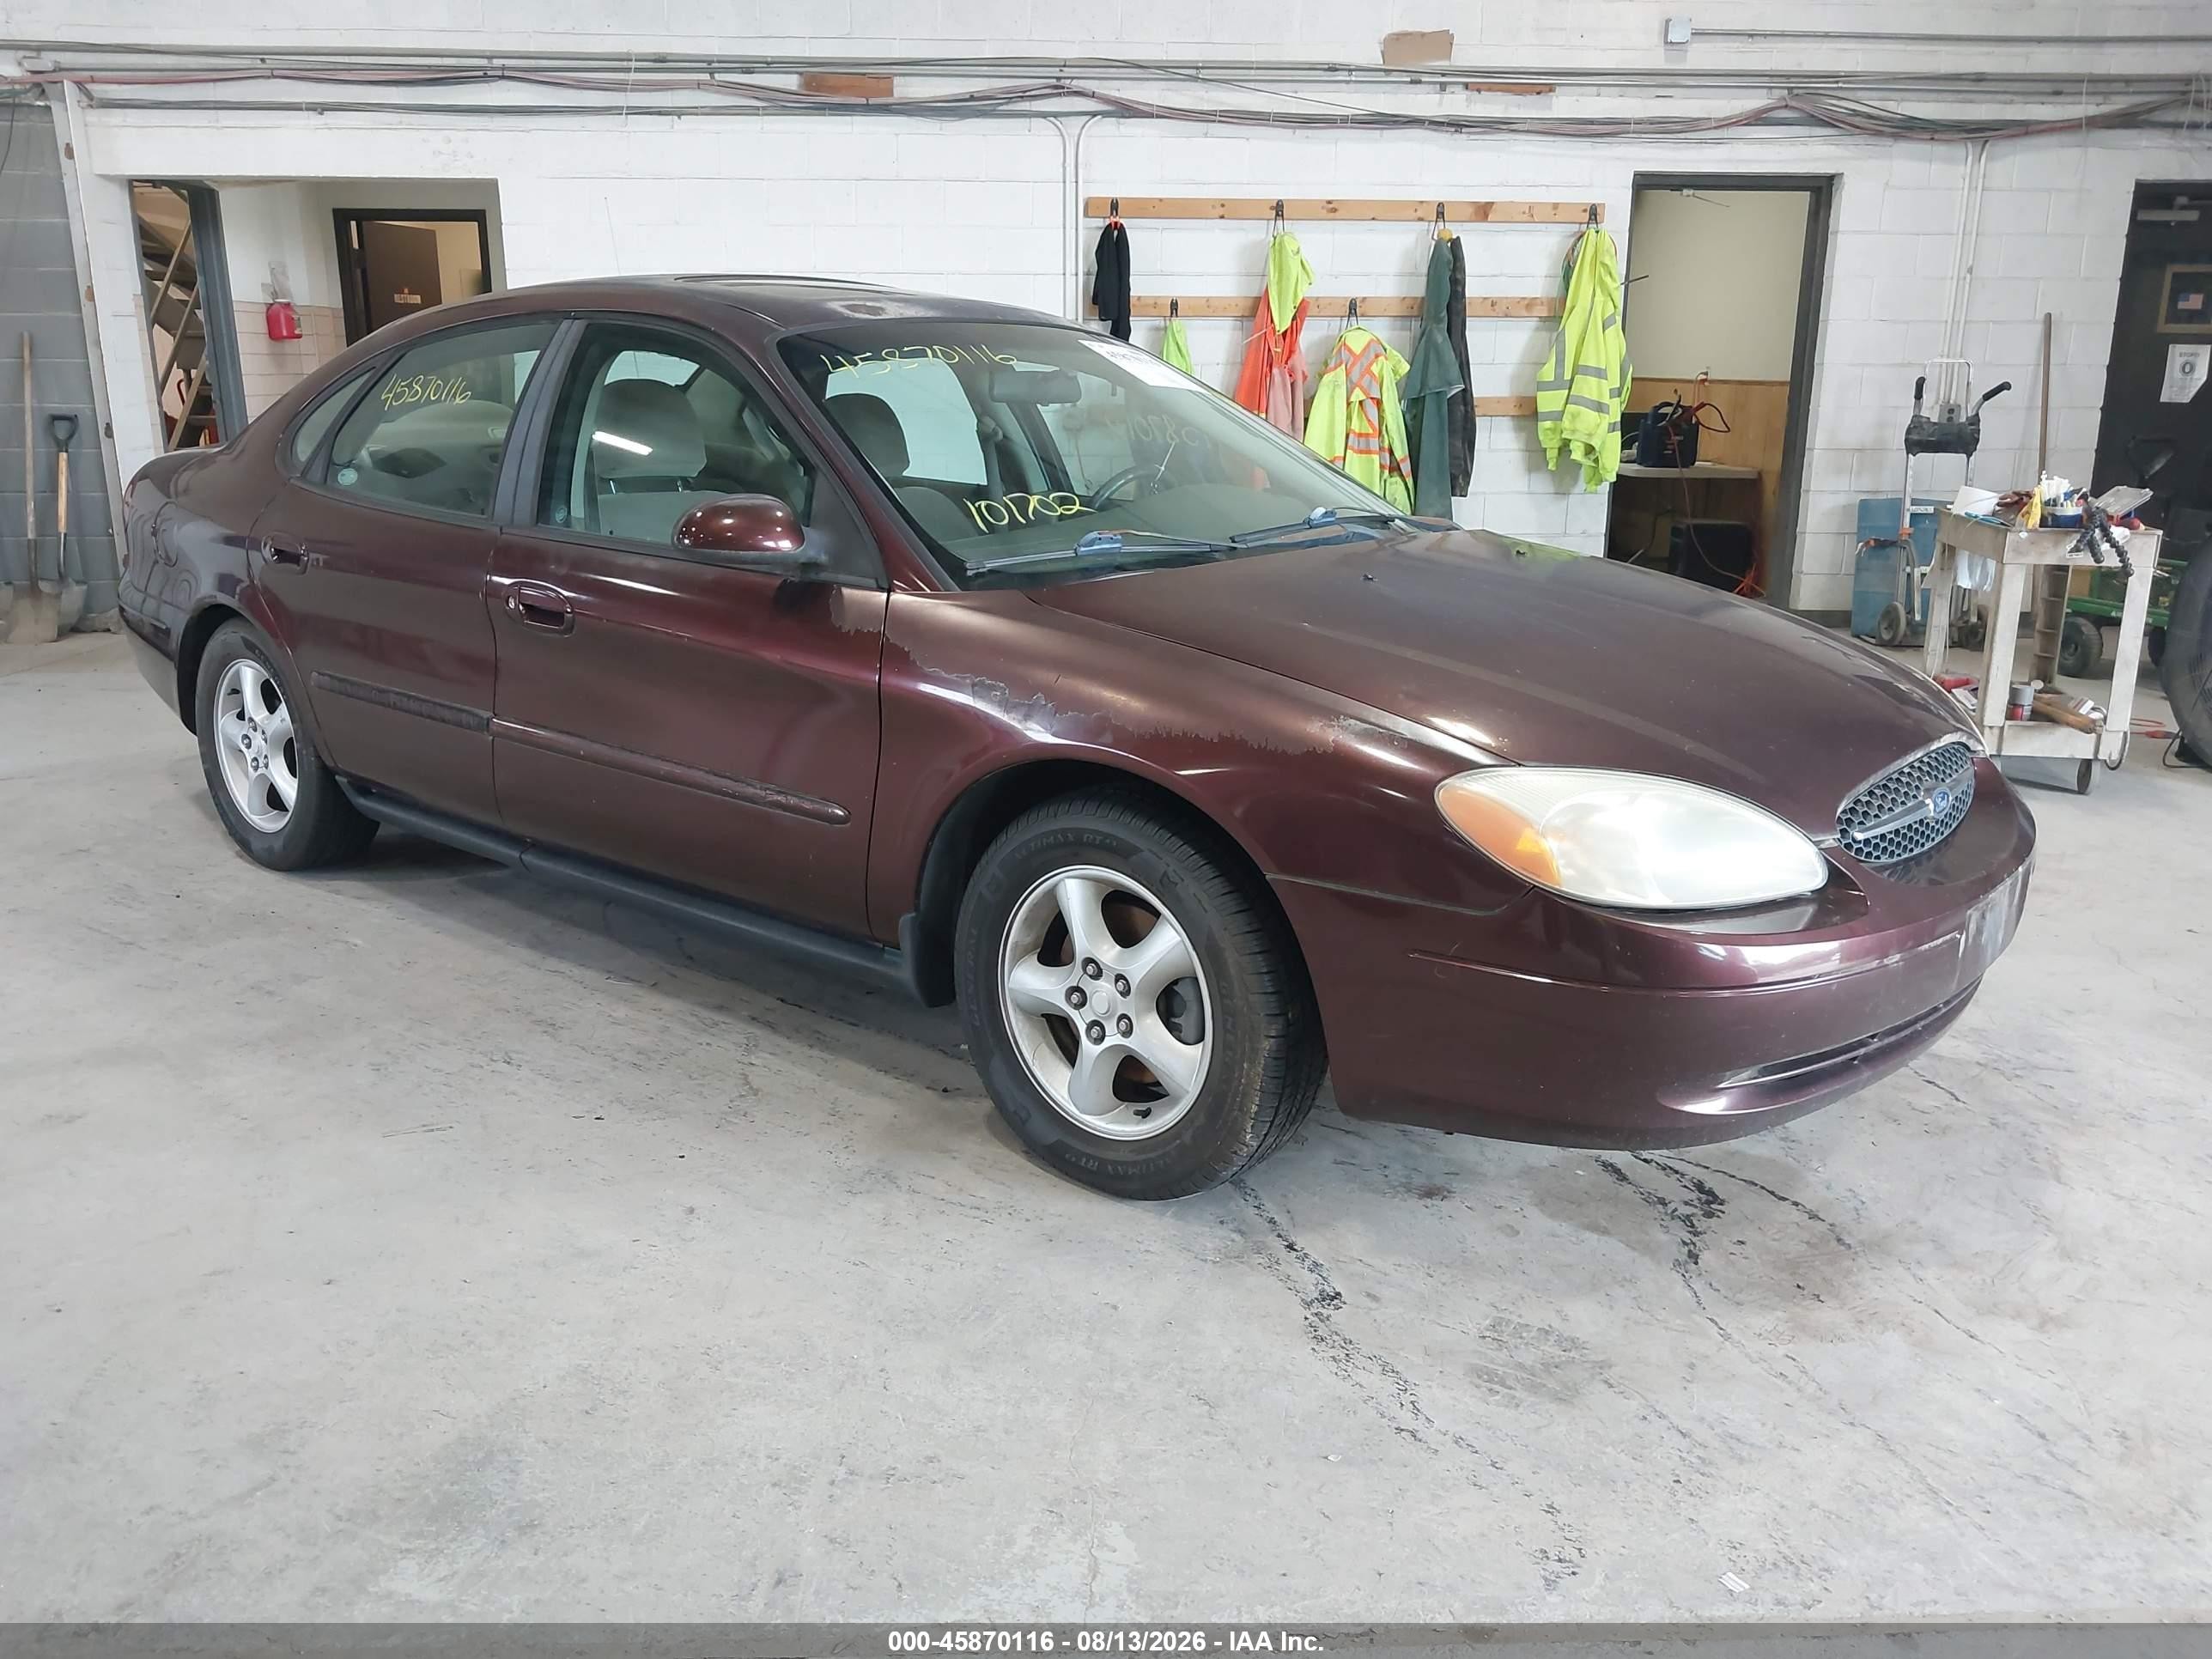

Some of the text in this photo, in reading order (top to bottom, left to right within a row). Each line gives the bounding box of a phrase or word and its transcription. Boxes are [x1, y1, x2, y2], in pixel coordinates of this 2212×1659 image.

[819, 343, 1018, 379] 45870116
[380, 373, 471, 411] 45870116
[962, 492, 1098, 534] 101702
